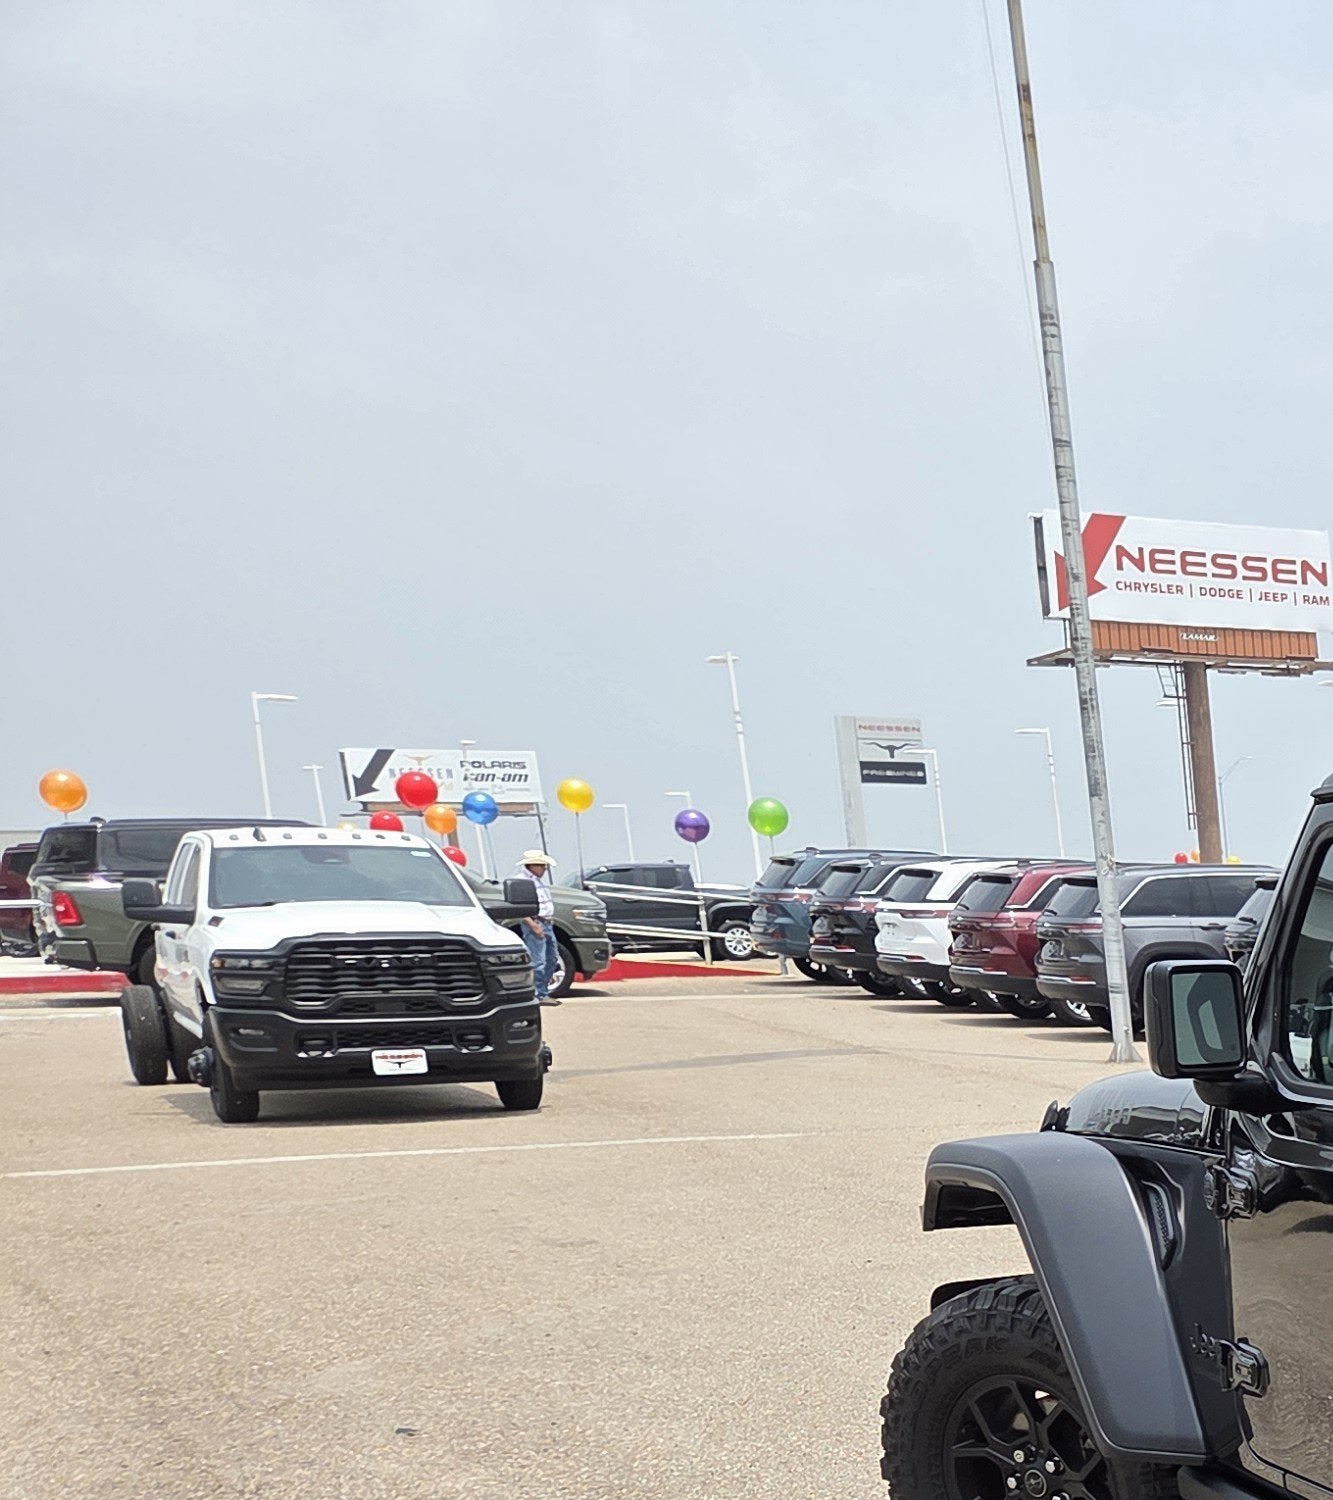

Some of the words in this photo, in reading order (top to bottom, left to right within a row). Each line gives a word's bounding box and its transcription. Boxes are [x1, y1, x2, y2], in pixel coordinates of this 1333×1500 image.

[1115, 545, 1328, 587] NEESSEN
[1115, 580, 1184, 596] CHRYSLER
[1199, 586, 1244, 600] DODGE
[1258, 591, 1288, 603] JEEP
[1302, 594, 1331, 607] RAM
[858, 724, 921, 733] NEESSEN
[460, 760, 527, 769] POLARIS
